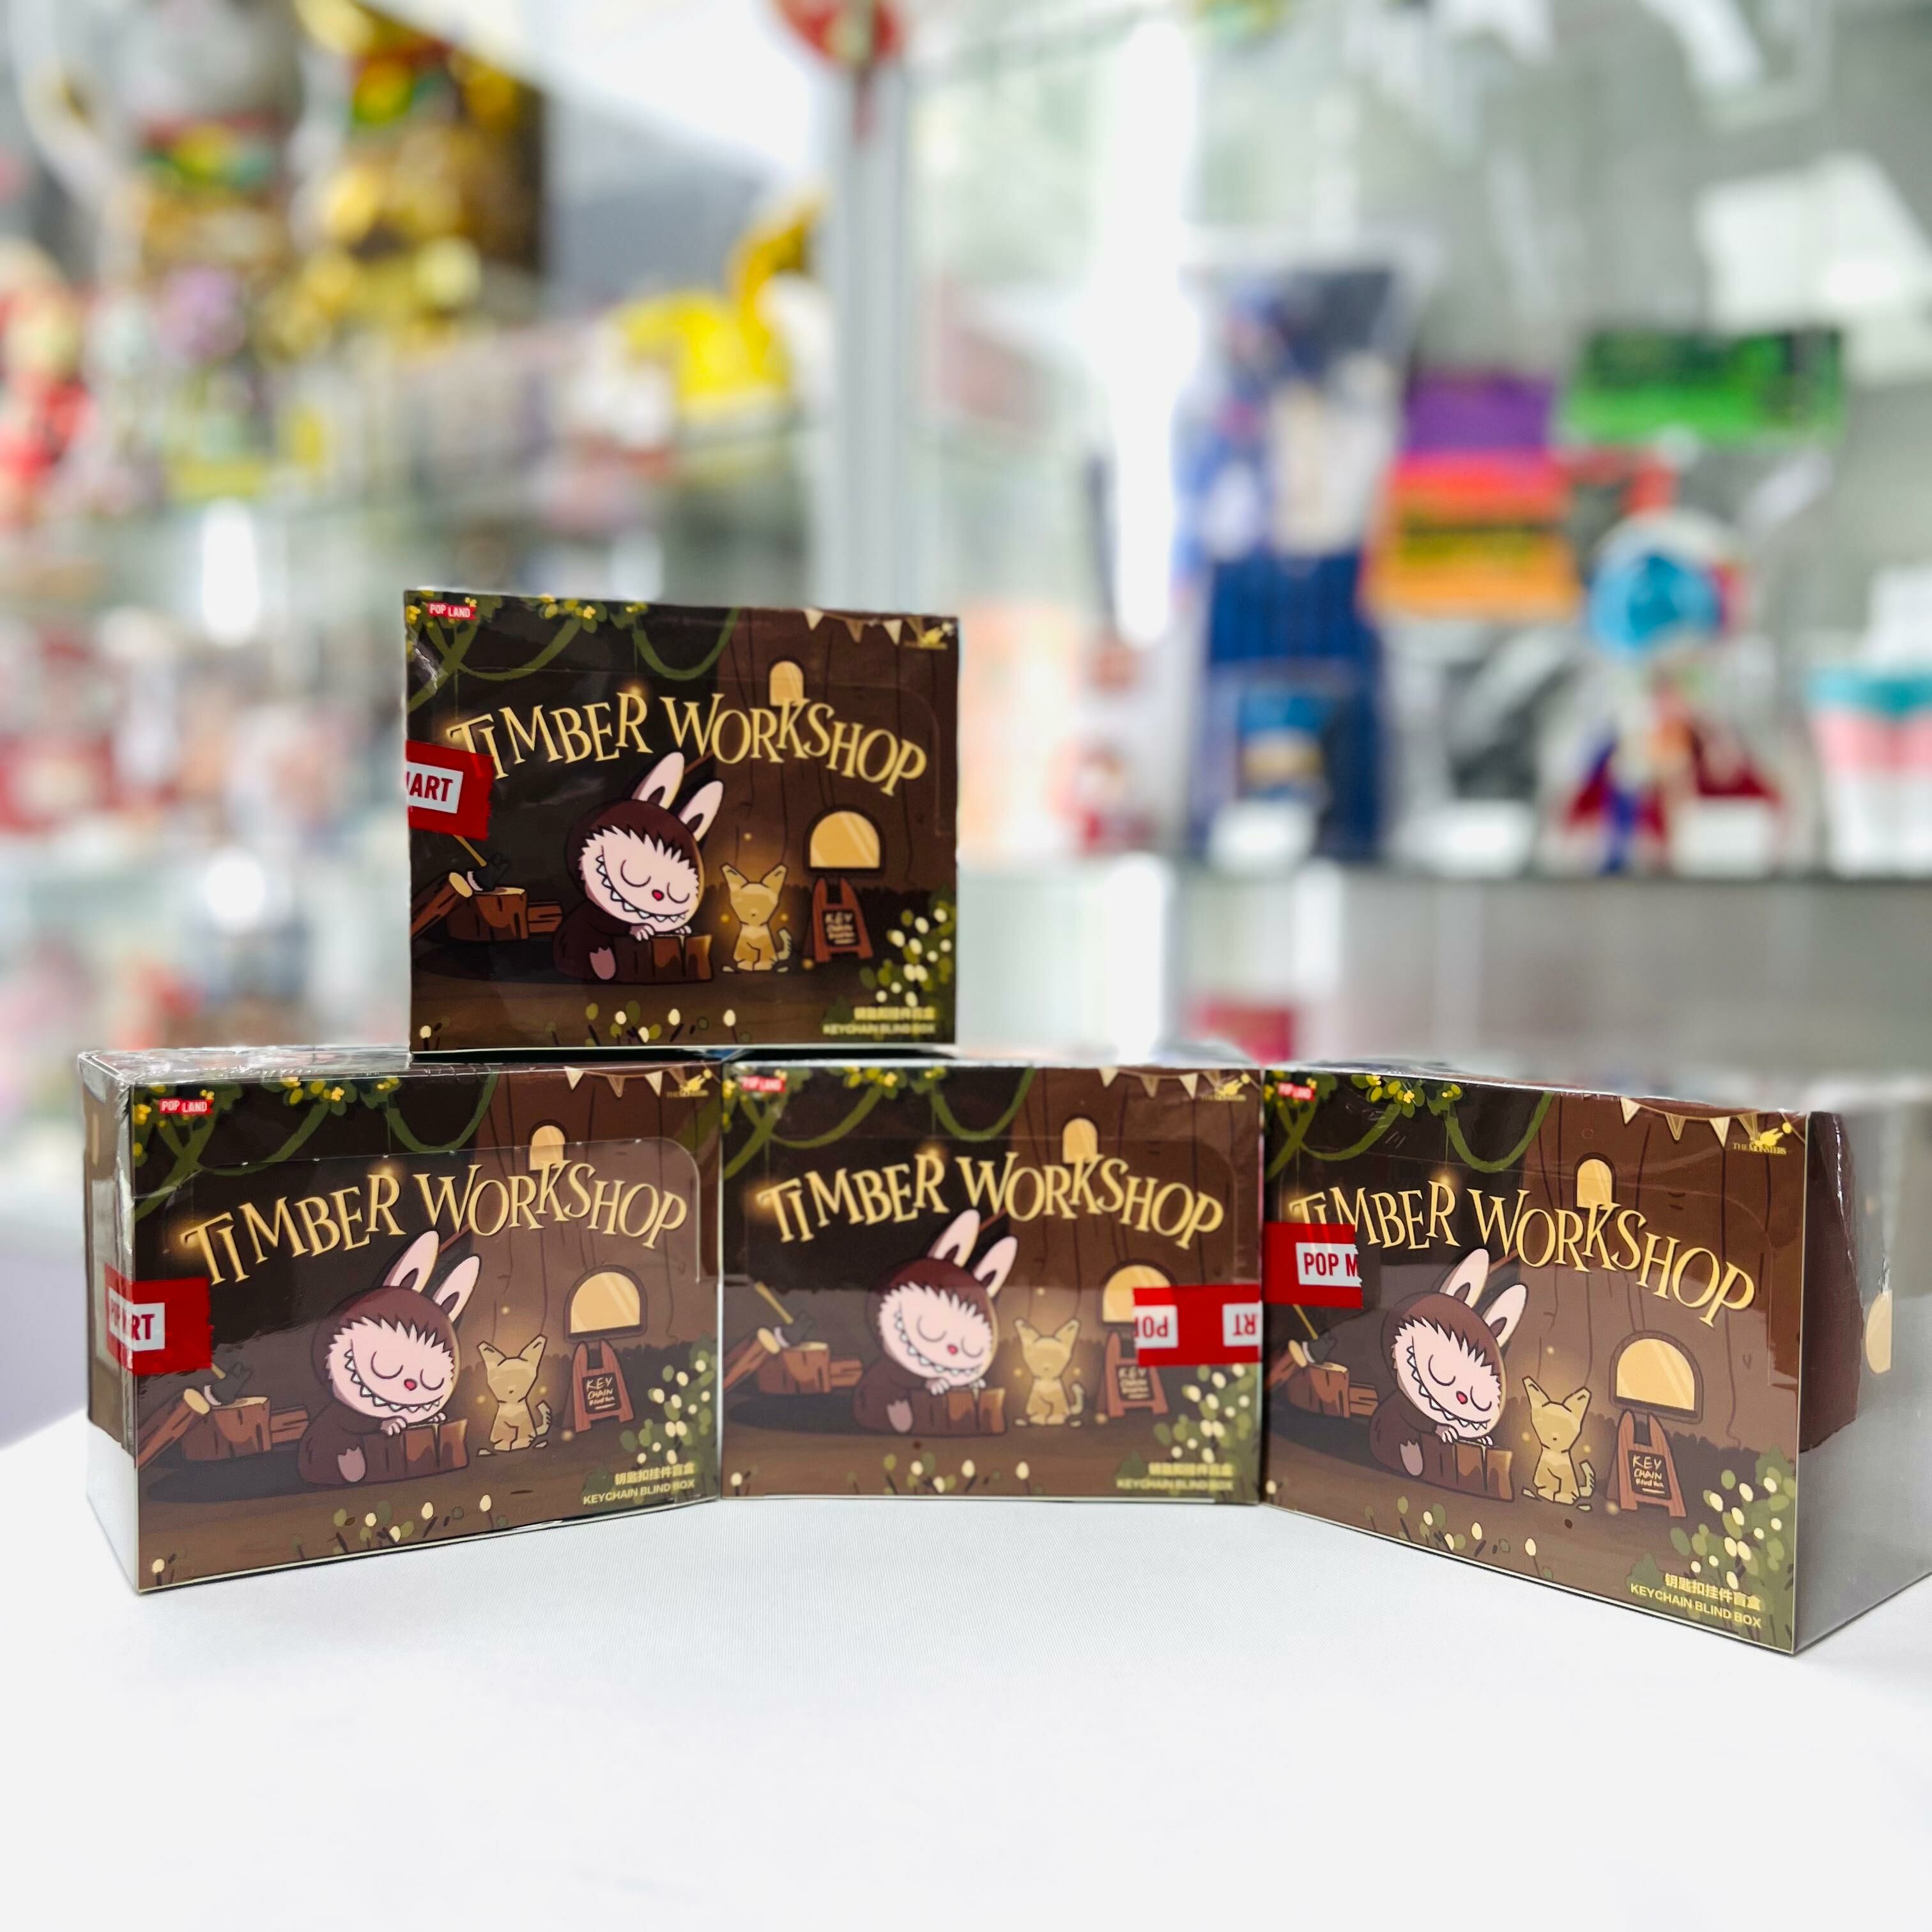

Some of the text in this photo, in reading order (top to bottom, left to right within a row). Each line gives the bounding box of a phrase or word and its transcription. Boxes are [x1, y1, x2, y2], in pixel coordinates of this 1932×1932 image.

[429, 604, 471, 618] POP LAND
[449, 693, 927, 797] TIMBER WORKSHOP
[162, 1100, 208, 1112] POP LAND
[756, 1152, 1224, 1249] TIMBER WORKSHOP
[180, 1160, 687, 1285] TIMBER WORKSHOP
[1289, 1181, 1755, 1328] TIMBER WORKSHOP
[1303, 1252, 1338, 1277] POP
[586, 1377, 613, 1392] KEY
[588, 1388, 613, 1400] CHAIN
[1632, 1454, 1662, 1470] KEY
[1634, 1468, 1662, 1480] CHAIN
[583, 1479, 695, 1505] KEYCHAIN BLIND BOX
[1665, 1573, 1761, 1611] 钥匙扣挂件盲盒
[1630, 1583, 1761, 1629] KEYCHAIN BLIND BOX
